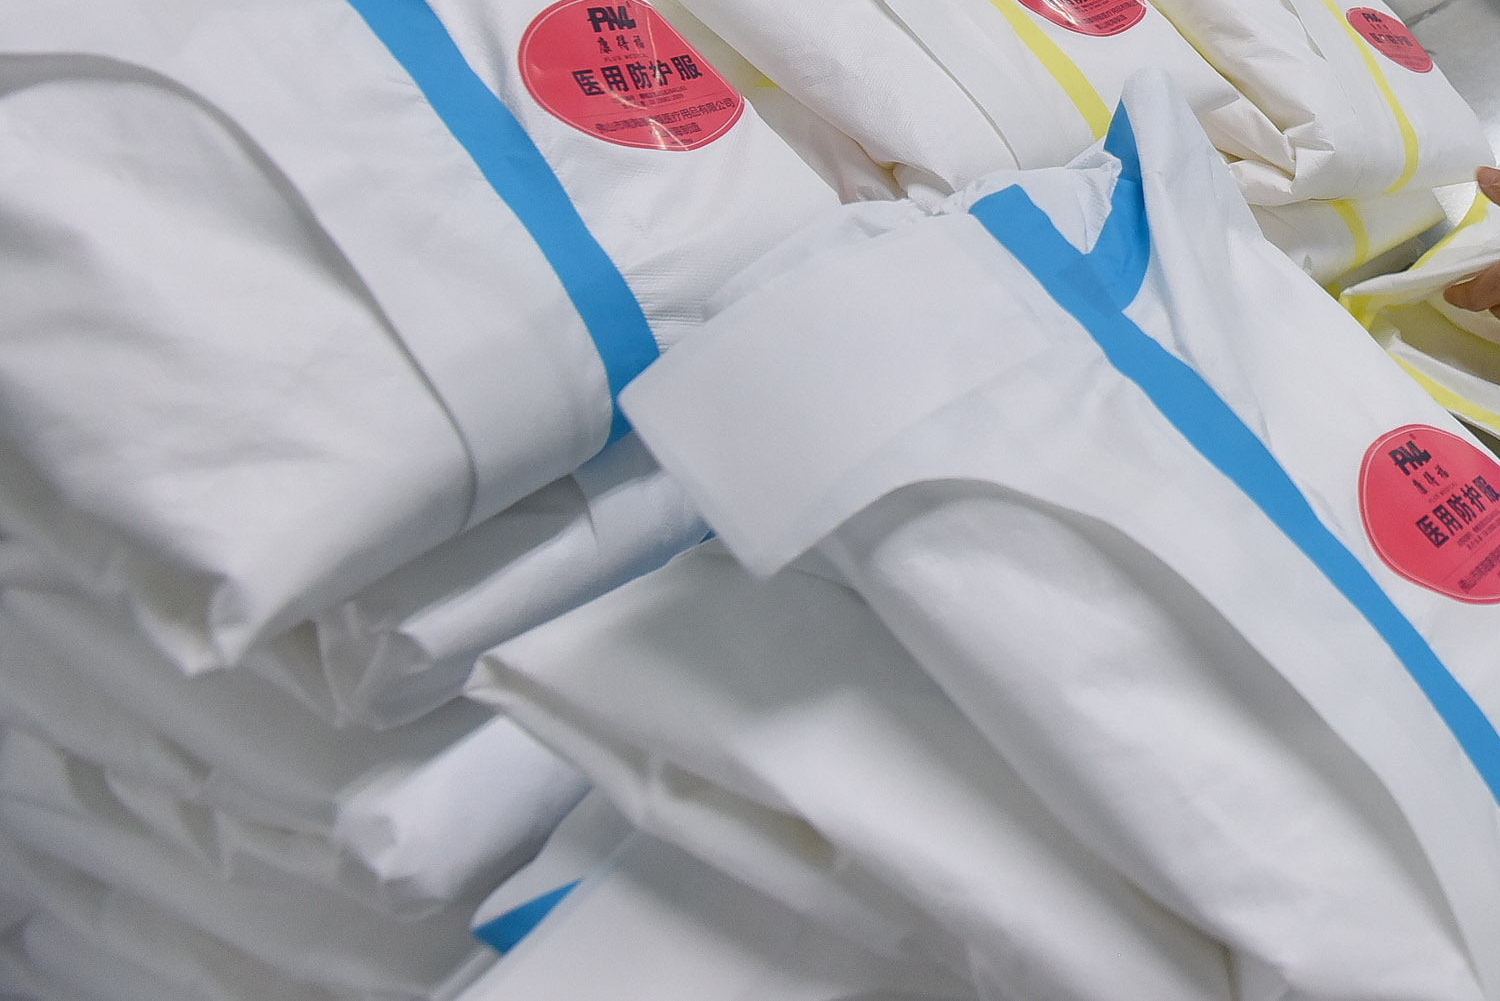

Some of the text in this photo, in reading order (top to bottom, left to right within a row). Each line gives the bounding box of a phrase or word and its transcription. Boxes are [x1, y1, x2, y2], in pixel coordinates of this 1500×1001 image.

[572, 54, 703, 97] 医用防护服
[1415, 475, 1500, 549] 医用防护服
